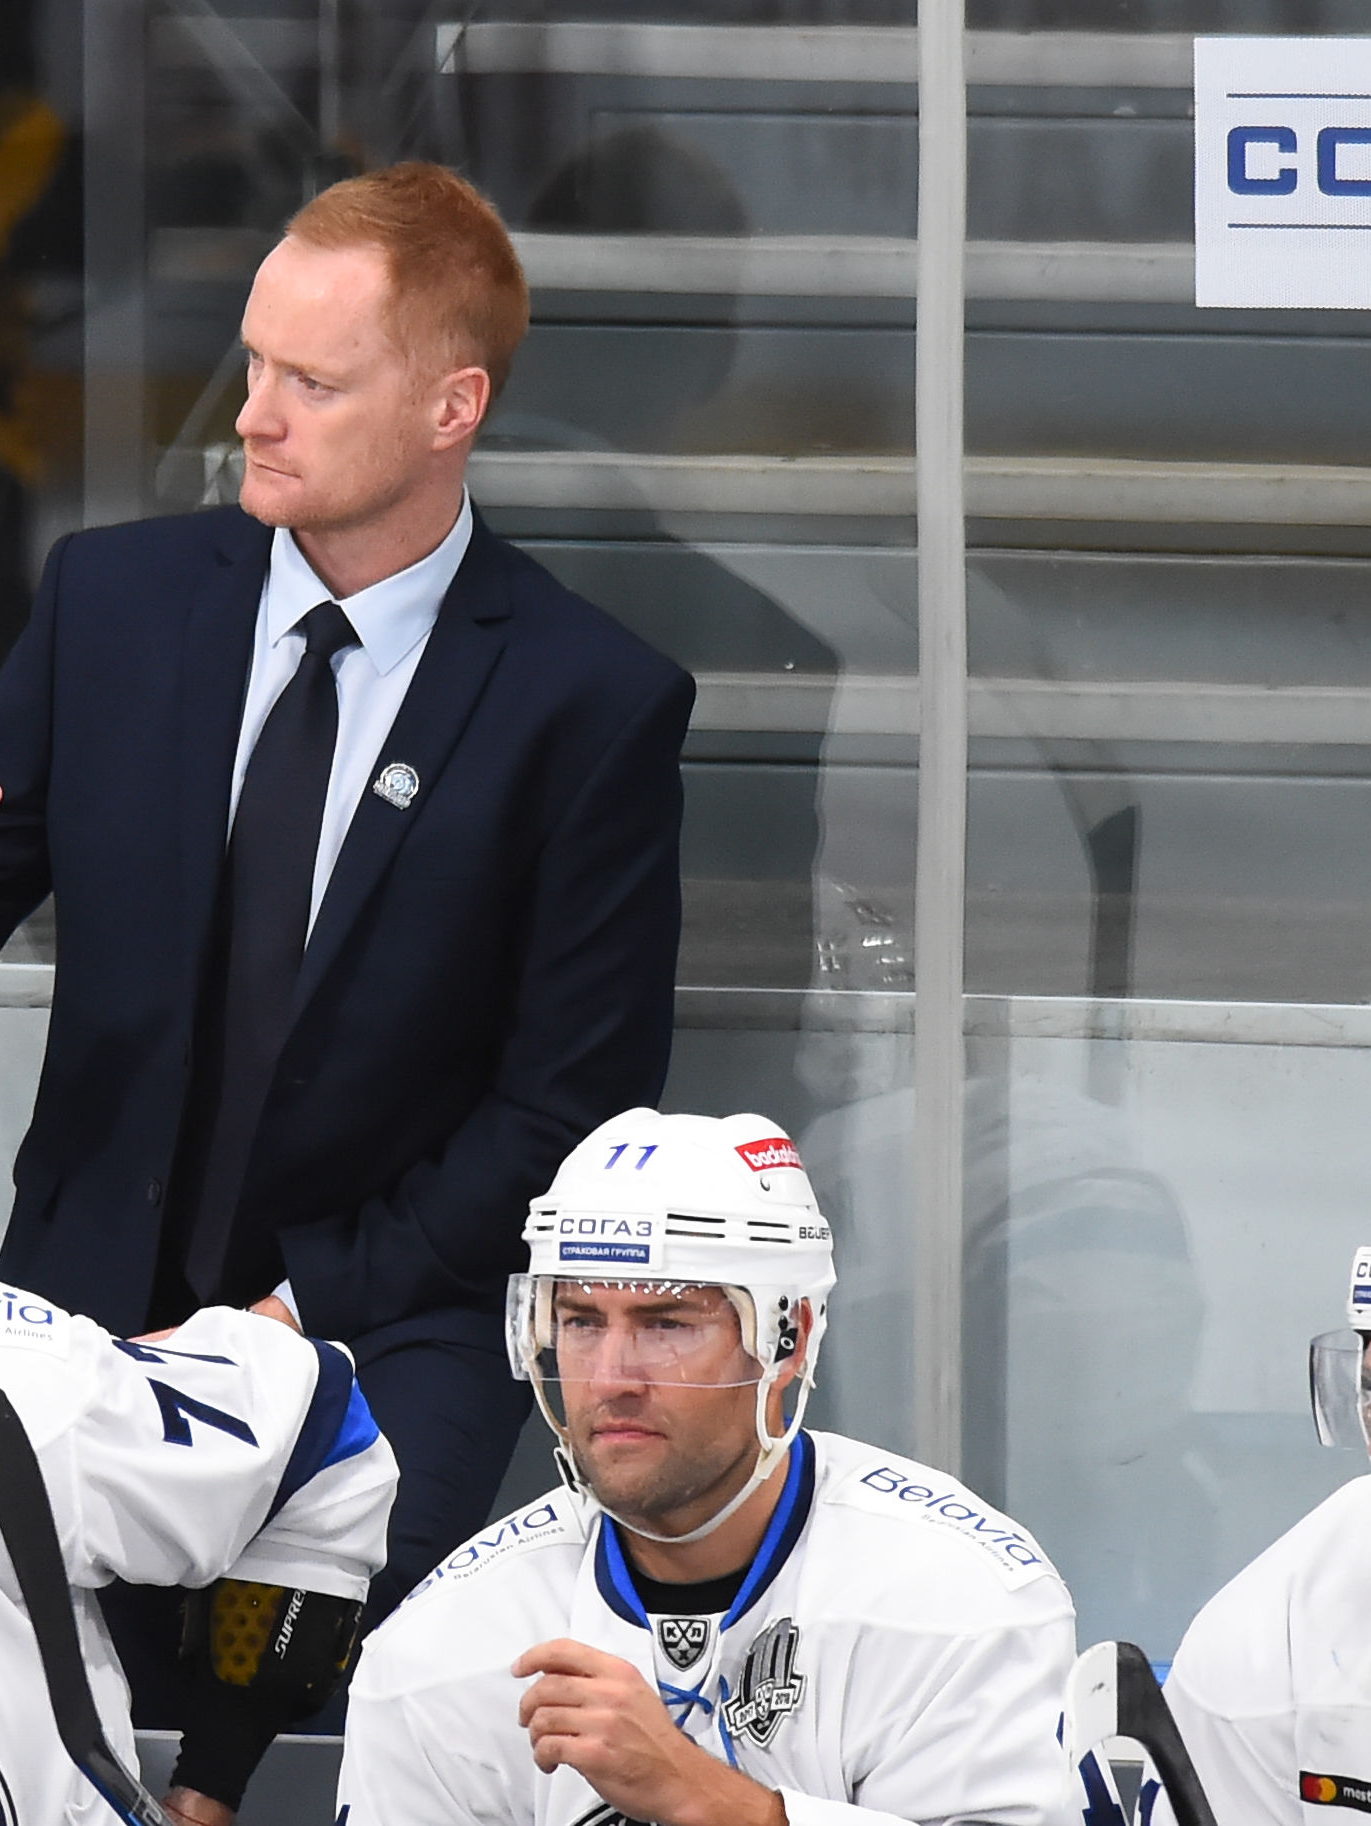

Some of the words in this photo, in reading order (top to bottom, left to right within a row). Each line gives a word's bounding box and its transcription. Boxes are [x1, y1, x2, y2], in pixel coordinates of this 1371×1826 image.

[604, 1143, 659, 1170] 11
[560, 1218, 653, 1237] СОГАЗ
[562, 1246, 610, 1257] СТРАХОВАЯ
[610, 1247, 646, 1258] ГРУППА
[5, 1326, 53, 1341] Airlines
[860, 1467, 1043, 1566] Belavia
